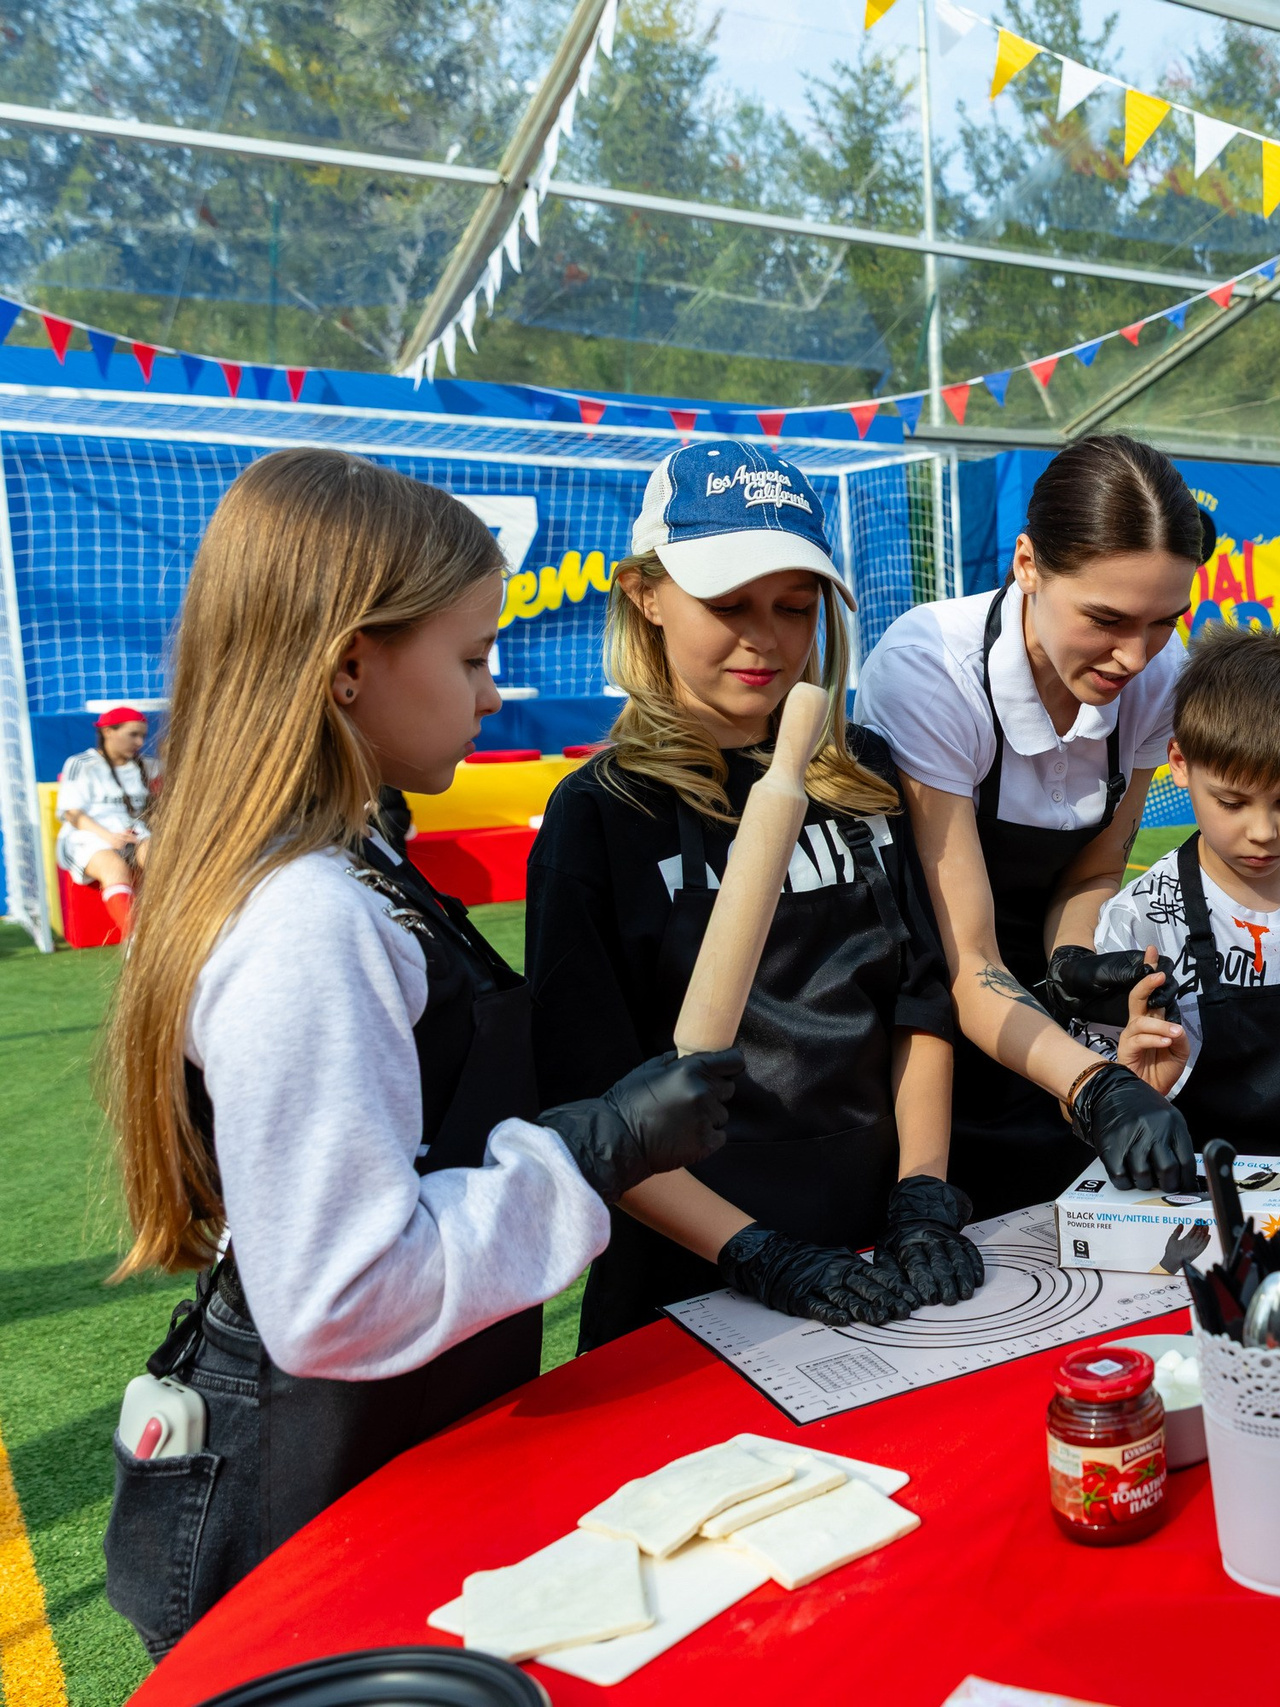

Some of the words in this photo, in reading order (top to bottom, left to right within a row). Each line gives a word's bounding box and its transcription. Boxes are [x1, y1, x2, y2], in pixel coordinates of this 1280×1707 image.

[706, 472, 732, 497] Los
[730, 464, 792, 488] Angeles
[743, 481, 812, 510] California
[1084, 1180, 1099, 1188] S
[1067, 1211, 1094, 1221] BLACK
[1096, 1213, 1160, 1224] VINYL/NITRILE
[1162, 1216, 1192, 1225] BLEND
[1067, 1221, 1095, 1229] POWDER
[1076, 1241, 1085, 1252] S
[1129, 1488, 1163, 1515] ПАСТА
